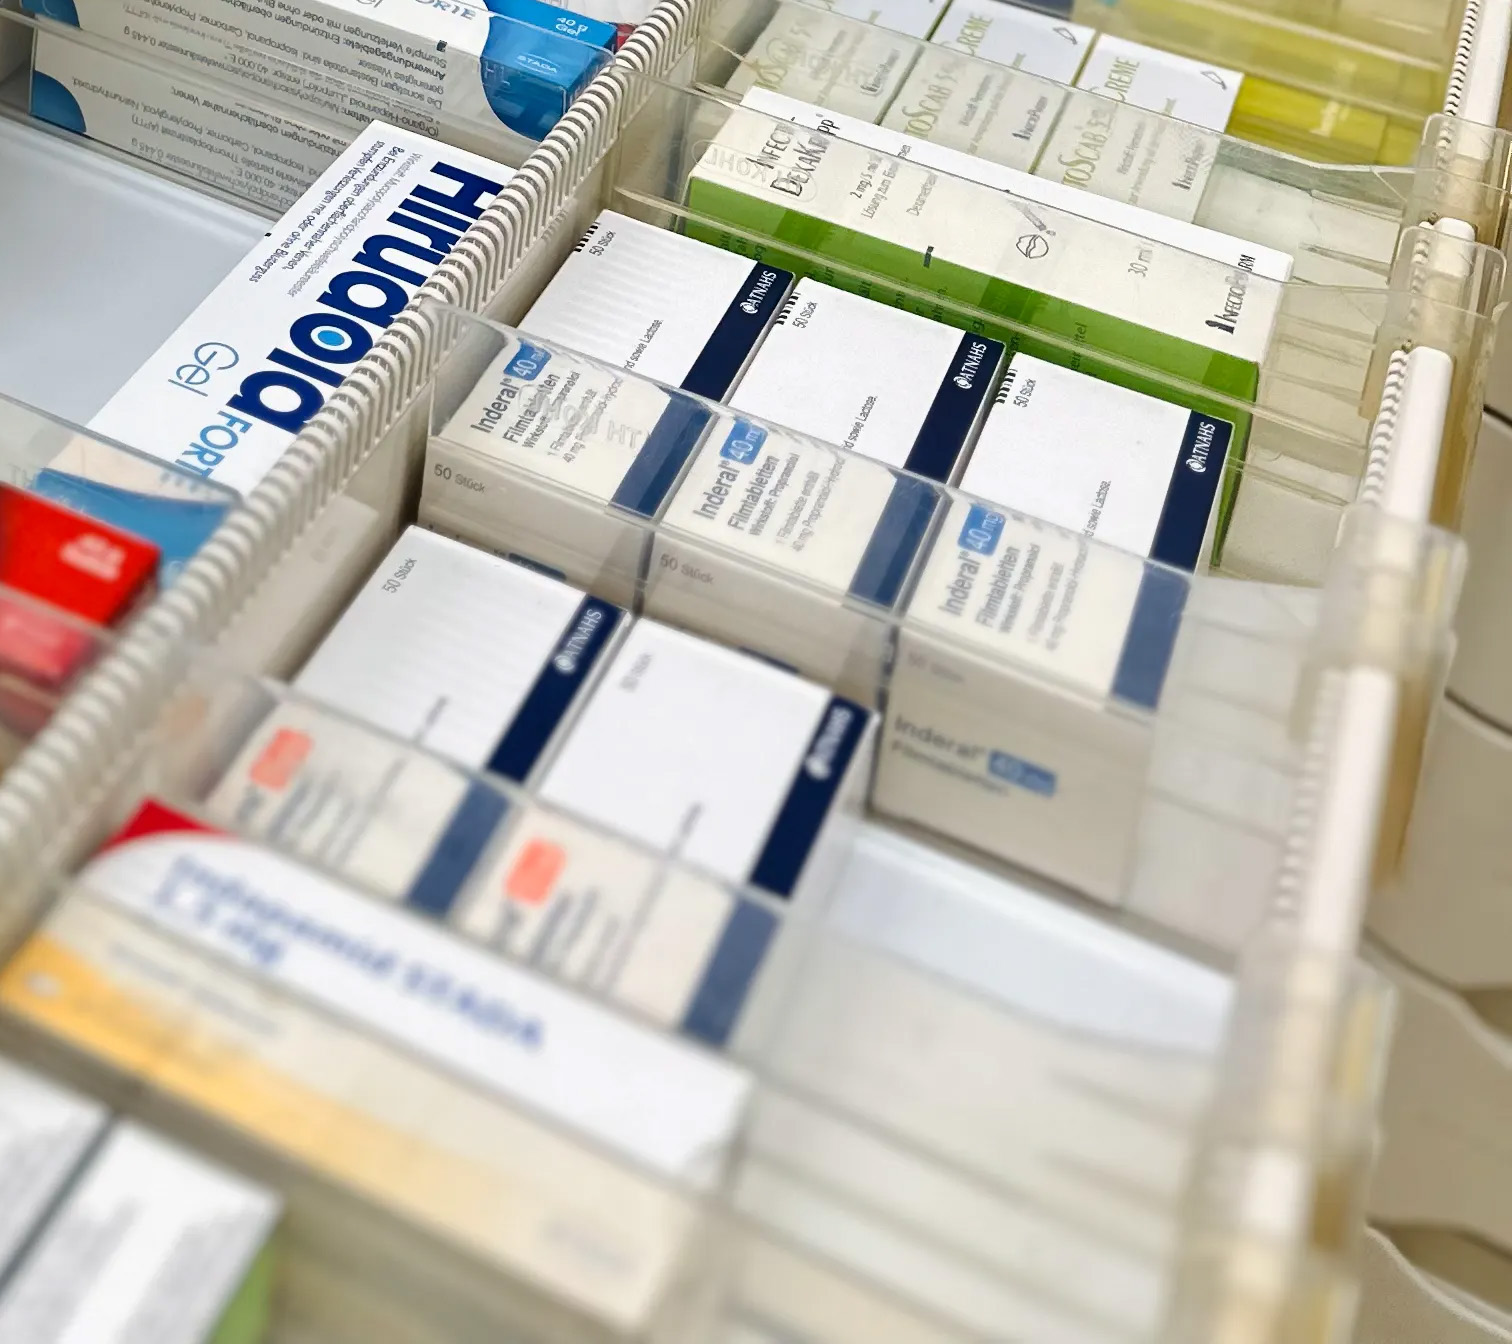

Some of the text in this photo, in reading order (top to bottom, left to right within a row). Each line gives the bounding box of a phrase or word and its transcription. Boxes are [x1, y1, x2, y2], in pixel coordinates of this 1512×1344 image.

[589, 242, 605, 257] 50
[226, 161, 506, 435] Hirudoid
[745, 269, 778, 308] ATNAHS
[792, 315, 808, 330] 50
[512, 358, 538, 378] 40
[959, 341, 988, 382] ATNAHS
[168, 342, 253, 480] Gel FORT
[1013, 393, 1030, 409] 50
[728, 439, 754, 460] 40
[1192, 421, 1217, 464] ATNAHS
[434, 463, 452, 481] 50
[727, 455, 781, 531] Filmtabletten
[965, 527, 992, 551] 40
[659, 552, 679, 572] 50
[381, 577, 403, 595] 50
